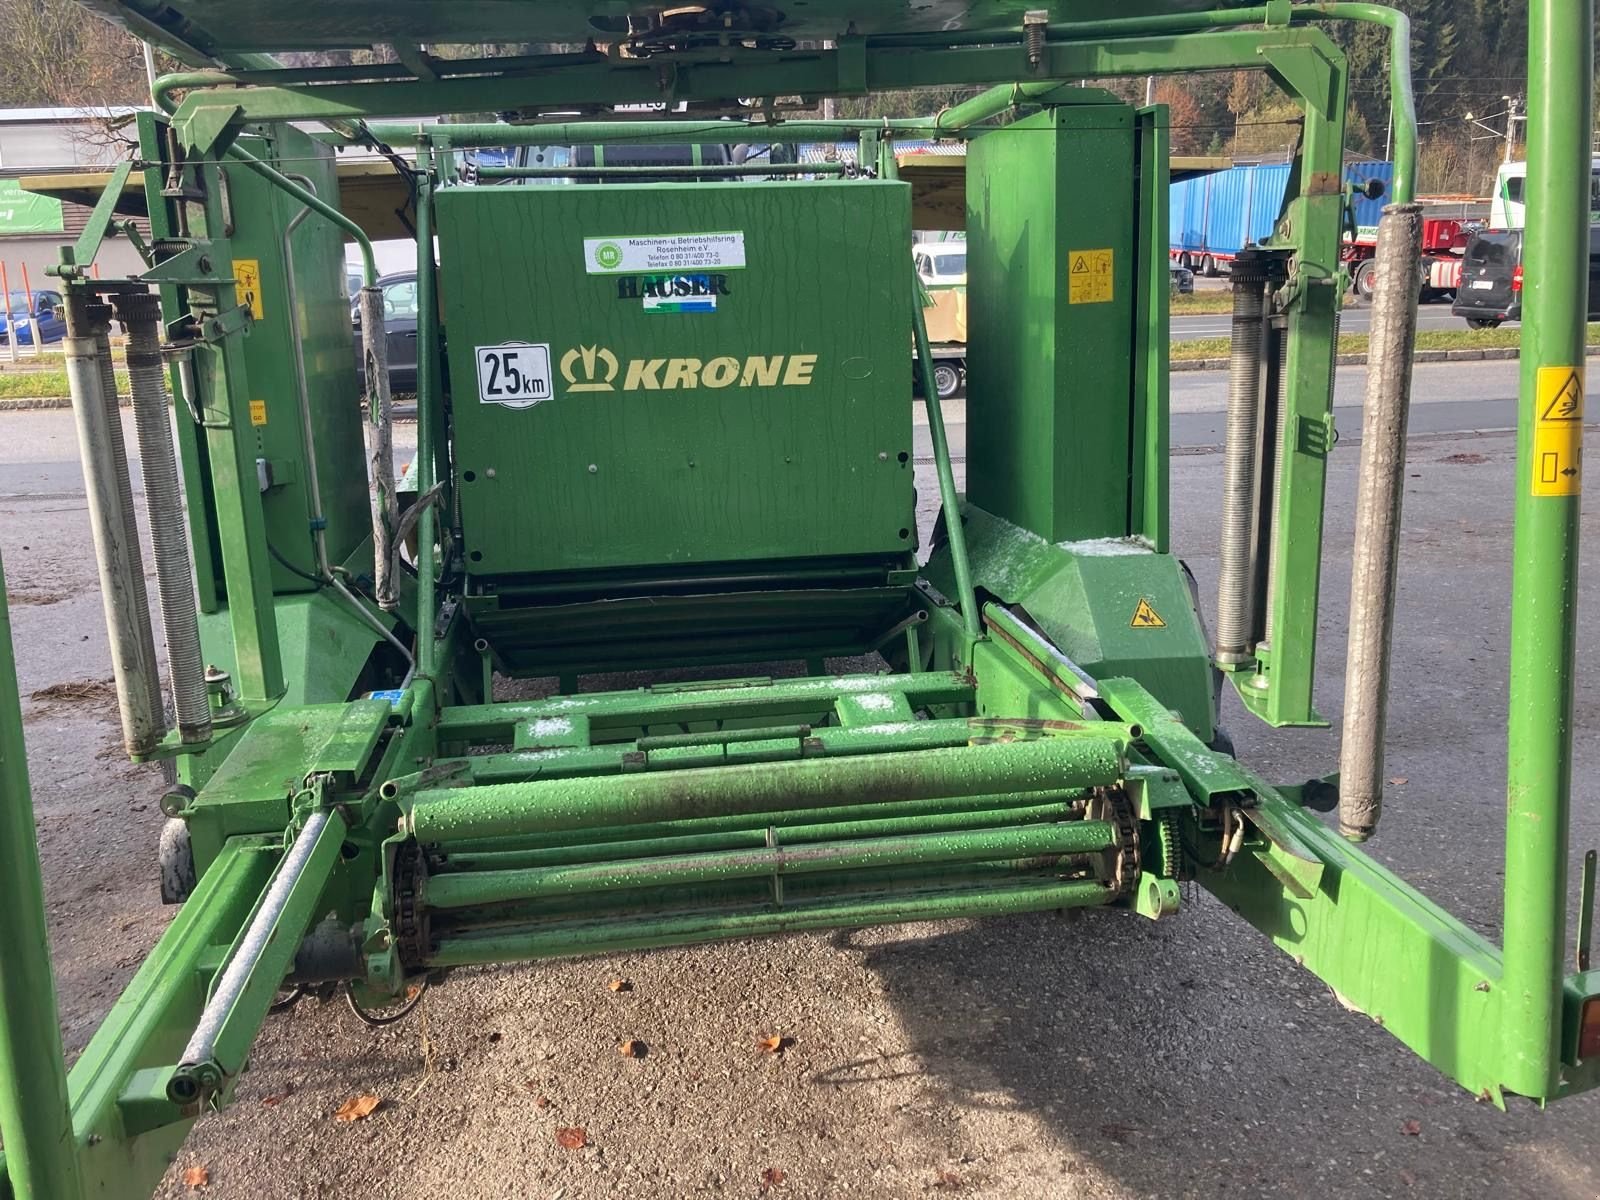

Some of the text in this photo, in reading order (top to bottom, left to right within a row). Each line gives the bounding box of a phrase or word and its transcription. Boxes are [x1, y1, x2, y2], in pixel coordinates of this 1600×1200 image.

[678, 236, 735, 244] Betriebshilfsring
[603, 251, 615, 260] MR
[617, 274, 731, 298] HAUSER
[484, 352, 545, 395] 25 km
[623, 354, 818, 390] KRONE
